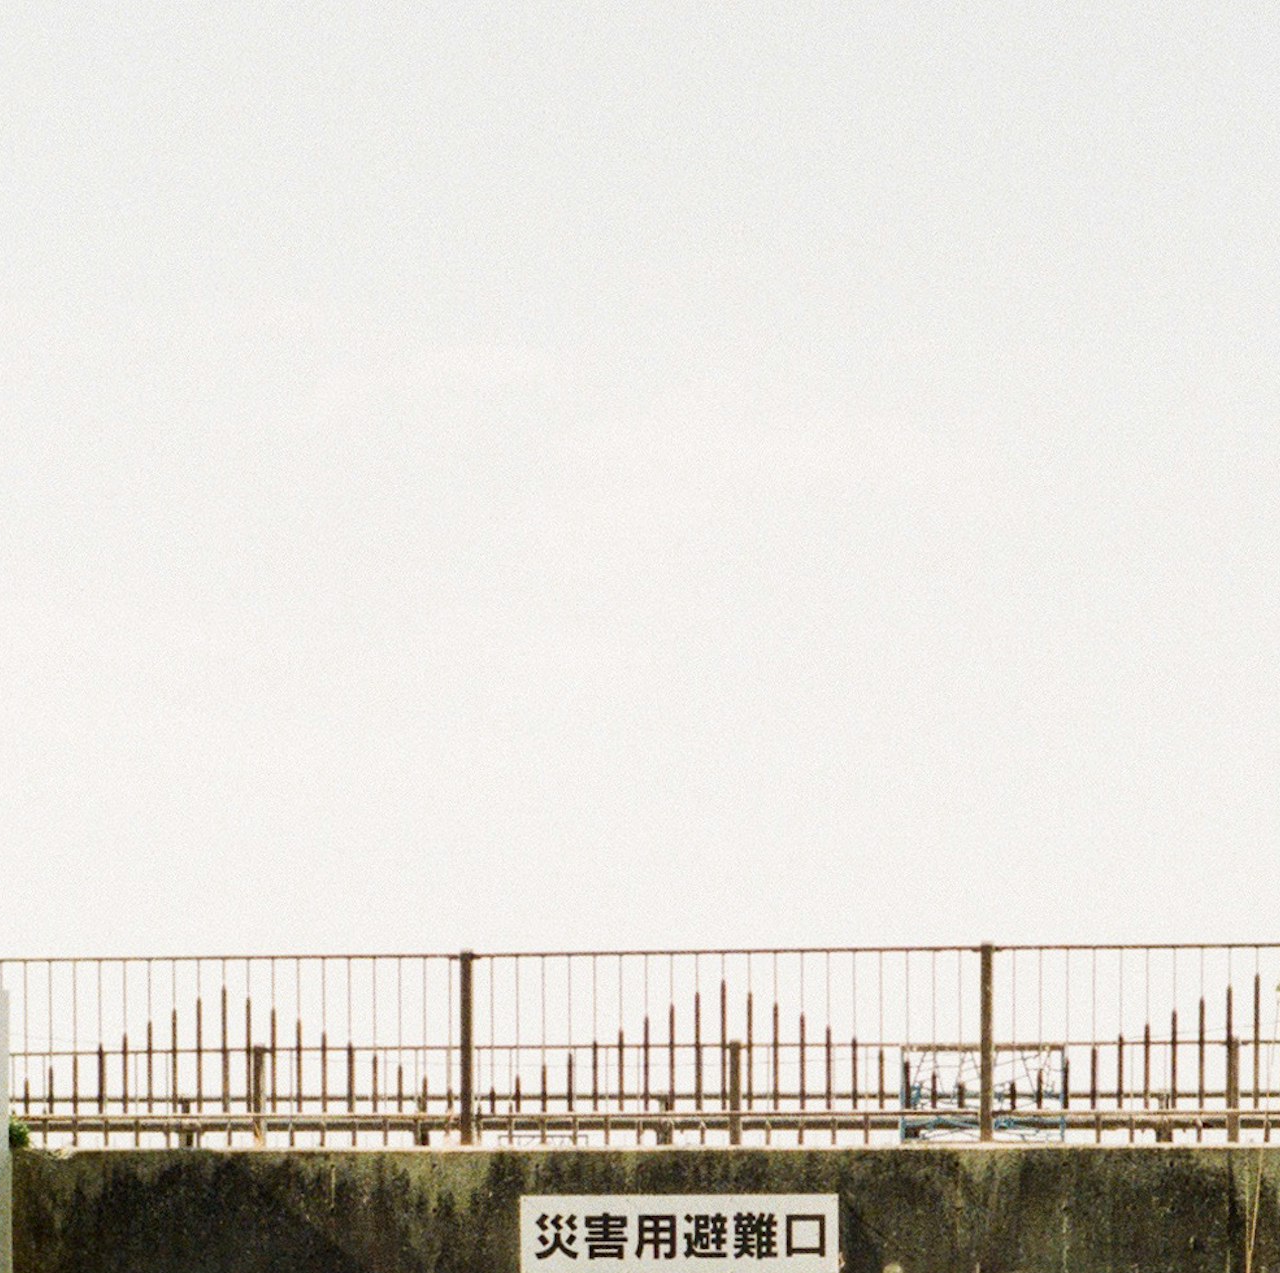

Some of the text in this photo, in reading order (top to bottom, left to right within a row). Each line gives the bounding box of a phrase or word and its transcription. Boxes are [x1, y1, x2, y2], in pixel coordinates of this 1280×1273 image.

[535, 1211, 827, 1260] 災害用避難口
